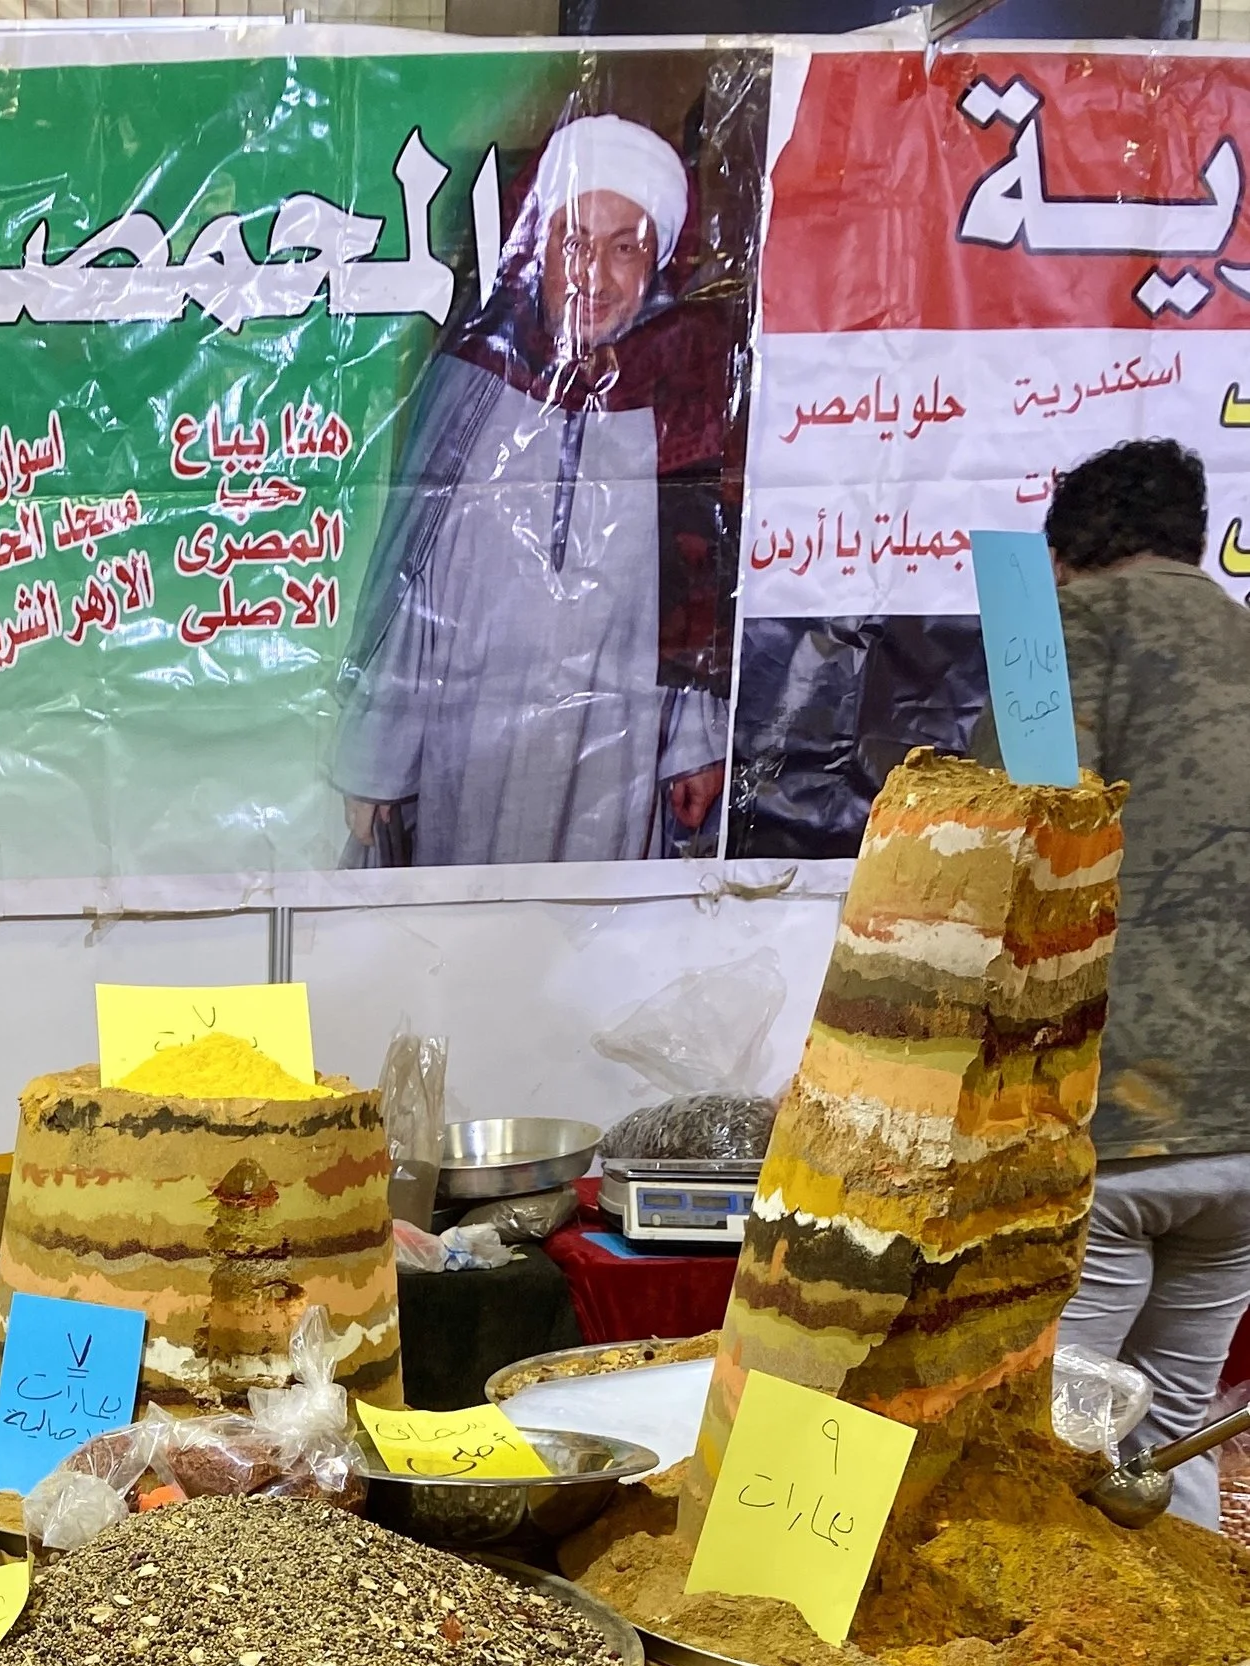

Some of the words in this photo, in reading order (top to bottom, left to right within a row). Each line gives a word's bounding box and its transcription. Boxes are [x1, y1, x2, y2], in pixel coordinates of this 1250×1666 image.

[1013, 351, 1182, 418] اسكندرية
[171, 401, 270, 478] يباع
[281, 402, 352, 460] هنا
[52, 490, 141, 562] مسجد
[750, 506, 828, 576] أردن
[836, 511, 862, 575] يا
[870, 510, 972, 572] جميلة
[66, 550, 155, 646] الازهر
[737, 1472, 854, 1551] بهارات
